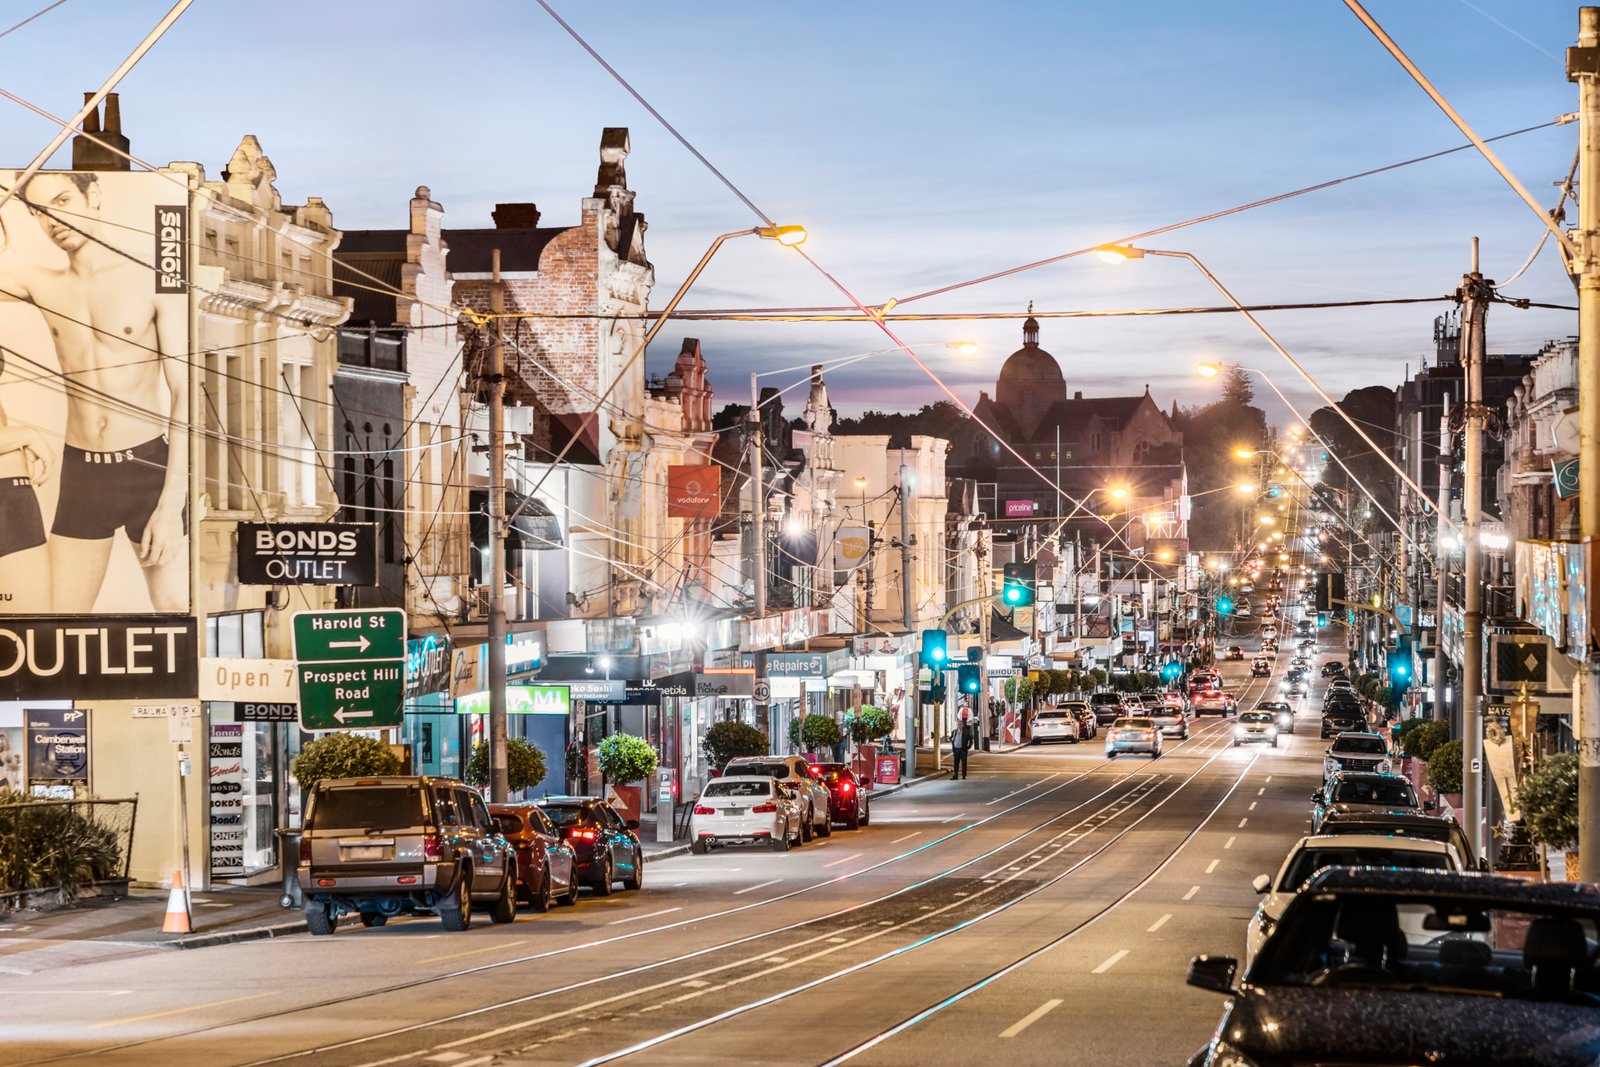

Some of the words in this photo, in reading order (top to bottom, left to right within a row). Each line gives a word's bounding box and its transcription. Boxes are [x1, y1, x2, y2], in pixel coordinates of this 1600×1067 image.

[85, 449, 135, 464] BONDS
[1008, 504, 1032, 513] priceline
[255, 530, 357, 551] BONDS
[265, 559, 347, 579] OUTLET
[312, 616, 362, 630] Harold
[369, 615, 386, 628] St
[773, 660, 809, 674] Repairs
[216, 666, 270, 689] Open
[283, 669, 294, 688] 7
[303, 669, 367, 686] Prospect
[373, 668, 400, 681] Hill
[335, 686, 370, 700] Road
[587, 684, 613, 692] Sushi
[754, 687, 769, 697] 40
[137, 707, 167, 716] RAILWA
[34, 735, 86, 744] Camberwell
[55, 744, 86, 754] Station
